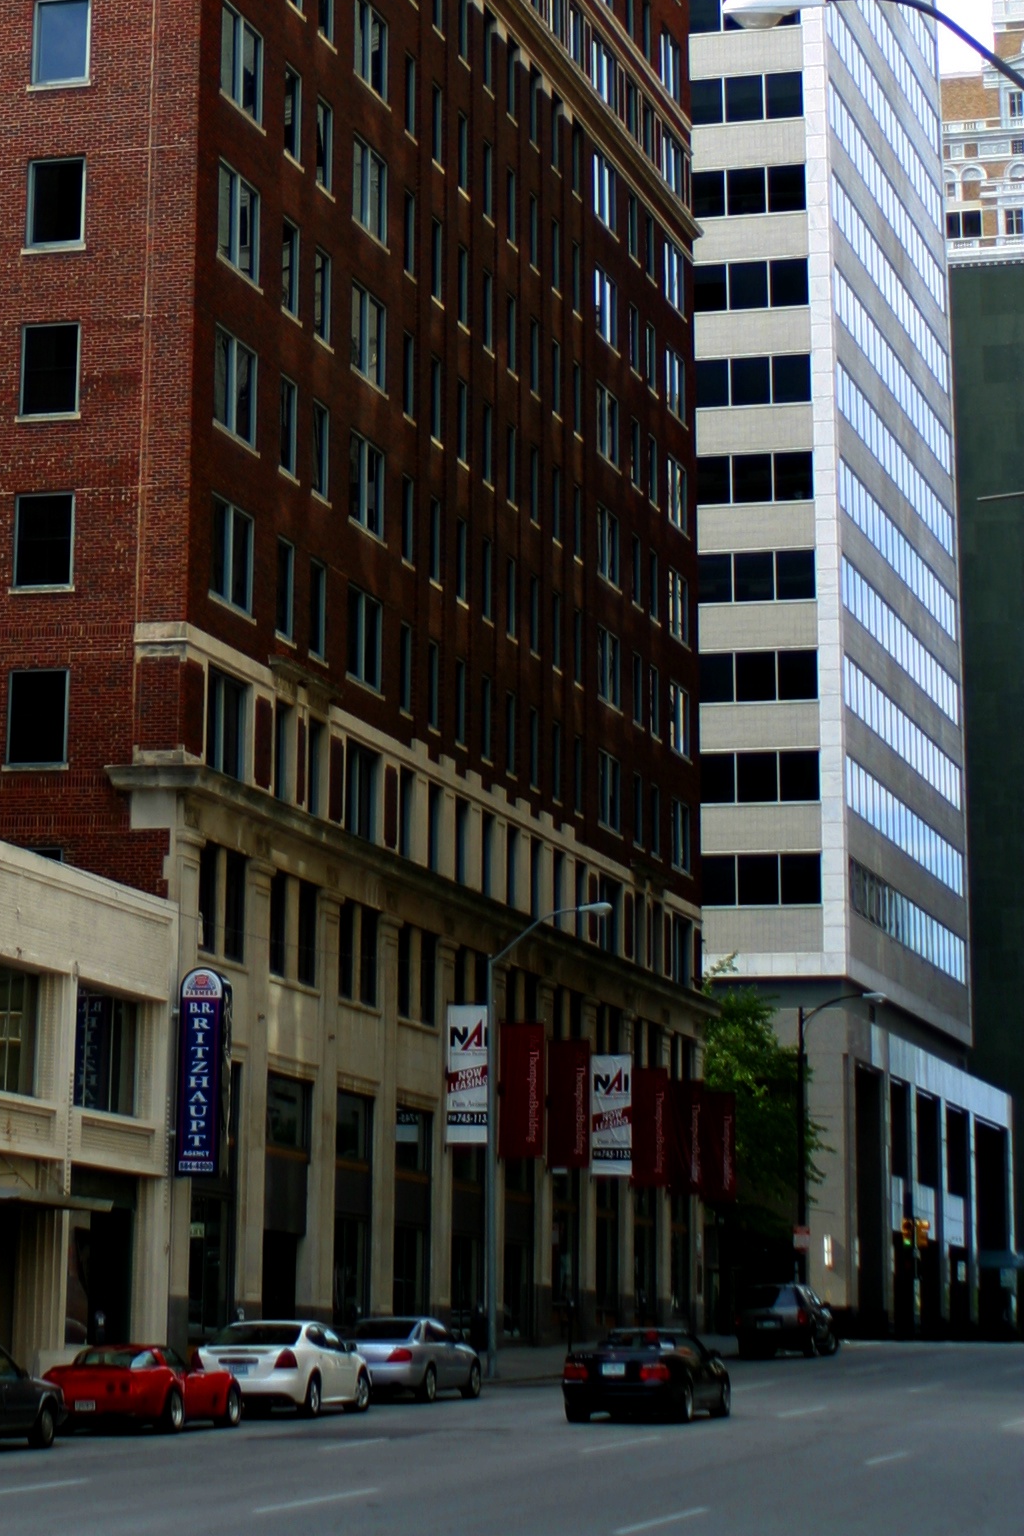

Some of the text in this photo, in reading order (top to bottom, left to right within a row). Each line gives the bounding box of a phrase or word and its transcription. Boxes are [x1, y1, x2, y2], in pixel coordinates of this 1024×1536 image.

[189, 1002, 214, 1014] B.R.
[457, 1066, 483, 1081] NOW
[594, 1067, 629, 1095] NAI
[188, 1017, 211, 1147] RITZHAUPT
[450, 1074, 488, 1092] LEASING
[602, 1108, 623, 1122] NOW
[183, 1150, 210, 1158] AGENCY
